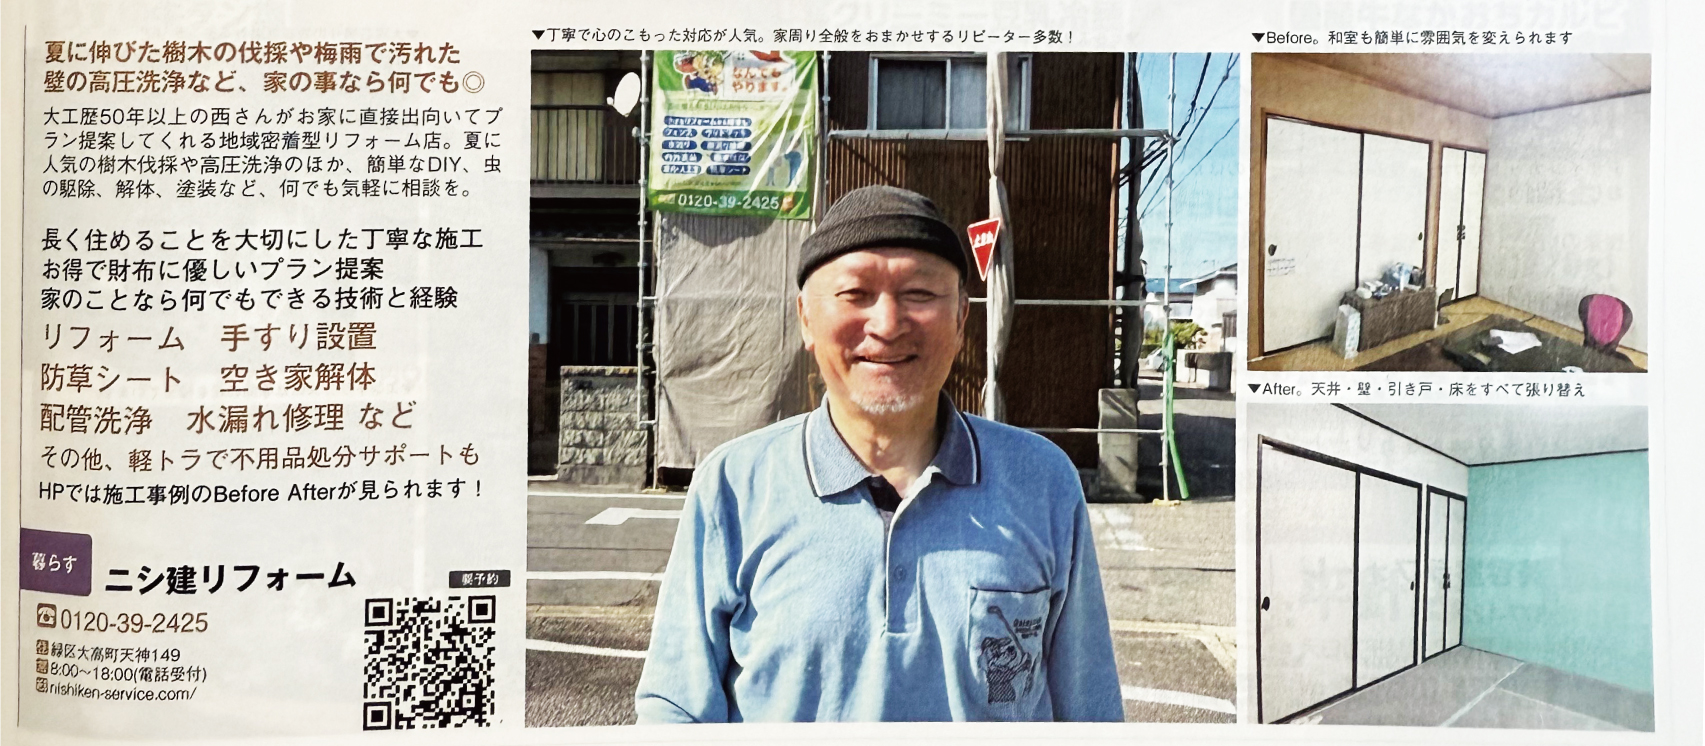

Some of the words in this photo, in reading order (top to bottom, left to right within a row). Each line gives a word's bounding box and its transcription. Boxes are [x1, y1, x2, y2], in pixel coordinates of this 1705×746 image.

[45, 40, 460, 64] 夏に伸びた樹木の伐採や梅雨で汚れた
[44, 107, 503, 126] 大工歴50年以上の西さんがお家に直接出向いてプ
[45, 131, 500, 150] ラン提案してくれる地域密着型リフォーム店。夏に
[43, 155, 501, 174] 人気の樹木伐採や高圧洗浄のほか、簡単なDIY、虫
[43, 179, 469, 199] の駆除、解体、塗装など、何でも気軽に相談を。
[678, 194, 780, 210] 0120-39-2425
[41, 227, 483, 251] 長く住めることを大切にした丁寧な施工
[42, 257, 383, 282] お得で財布に優しいプラン提案
[41, 286, 458, 312] 家のことなら何でもできる技術と経験
[45, 324, 184, 352] リフォーム
[221, 322, 377, 352] 手すり設置
[41, 363, 180, 393] 防草シート
[220, 362, 376, 392] 空き家解体
[40, 403, 152, 435] 配管洗浄
[187, 403, 344, 434] 水漏れ修理
[359, 401, 416, 430] など
[41, 443, 478, 472] その他、軽トラで不用品処分サポートも
[39, 482, 279, 505] HPでは施工事例のBefore
[105, 562, 356, 595] ニシ建リフォーム
[61, 609, 208, 633] 0120-39-2425
[50, 681, 197, 701] nishiken-service.com/
